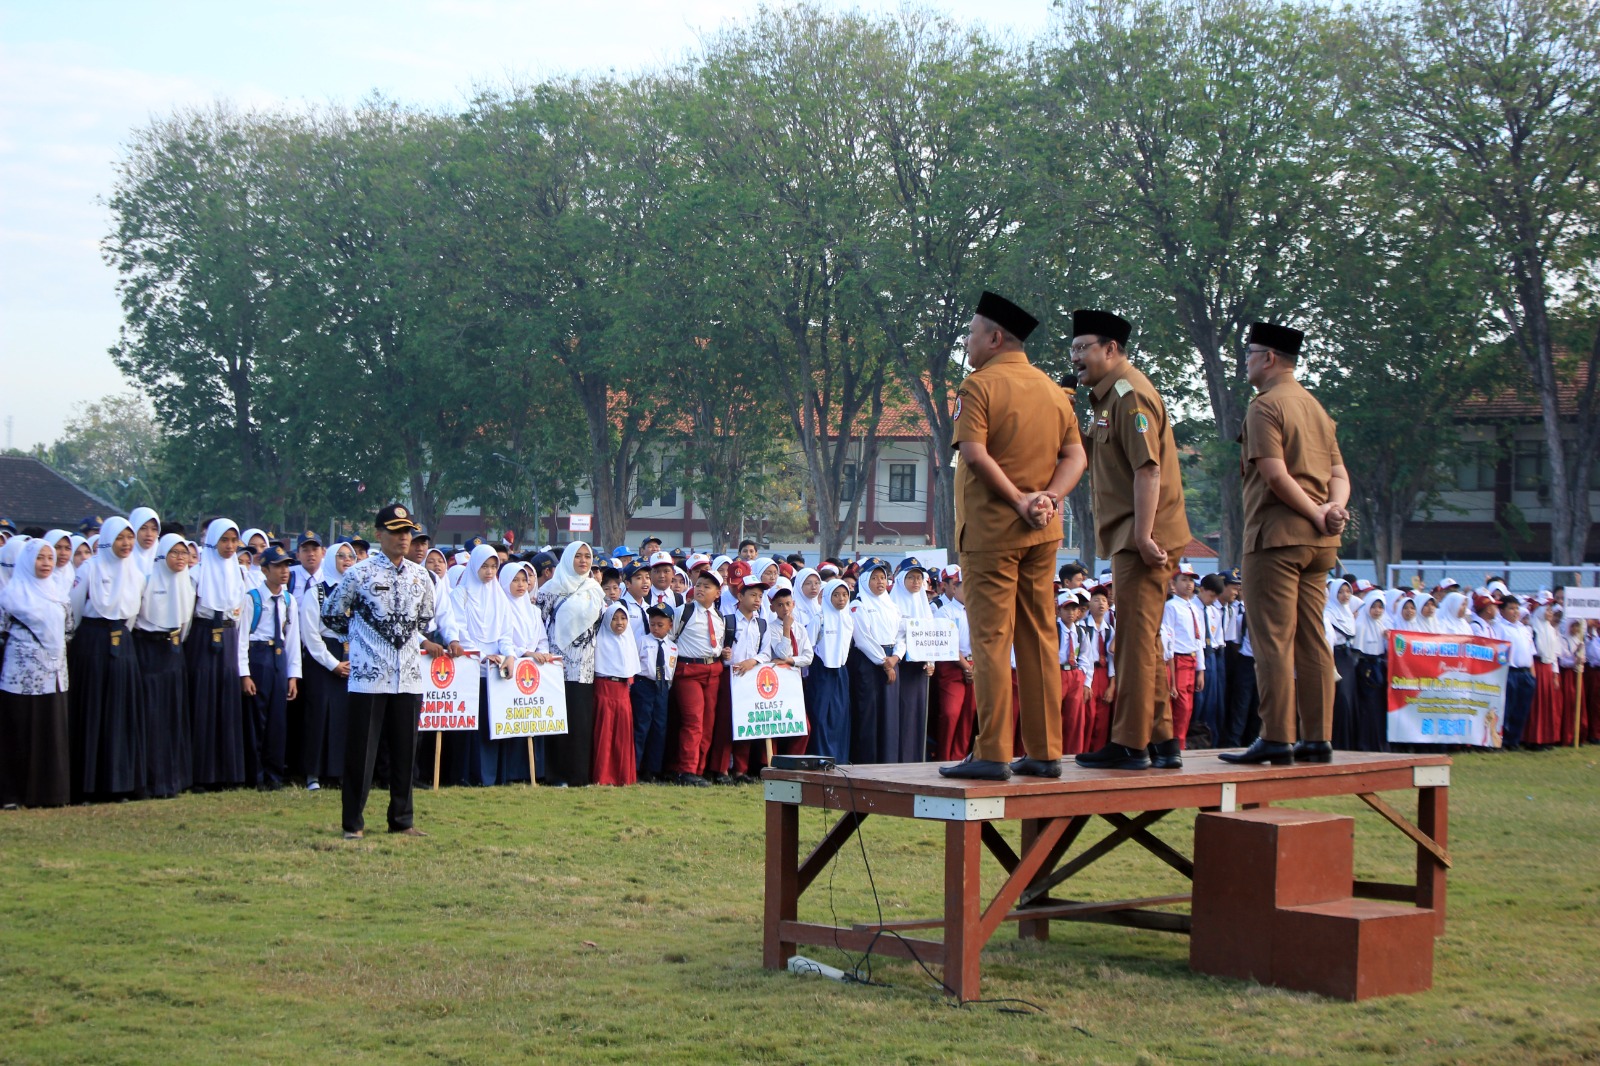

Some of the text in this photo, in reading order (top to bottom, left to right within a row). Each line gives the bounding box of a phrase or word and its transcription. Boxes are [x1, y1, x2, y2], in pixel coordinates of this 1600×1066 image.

[427, 691, 457, 699] KELAS 9
[514, 697, 538, 706] KELAS
[457, 701, 465, 713] 4
[755, 701, 778, 710] KELAS
[506, 706, 554, 720] SMPN 4
[748, 709, 793, 723] SMPN 4
[496, 719, 565, 735] PASURUAN
[738, 721, 804, 737] PASURUAN
